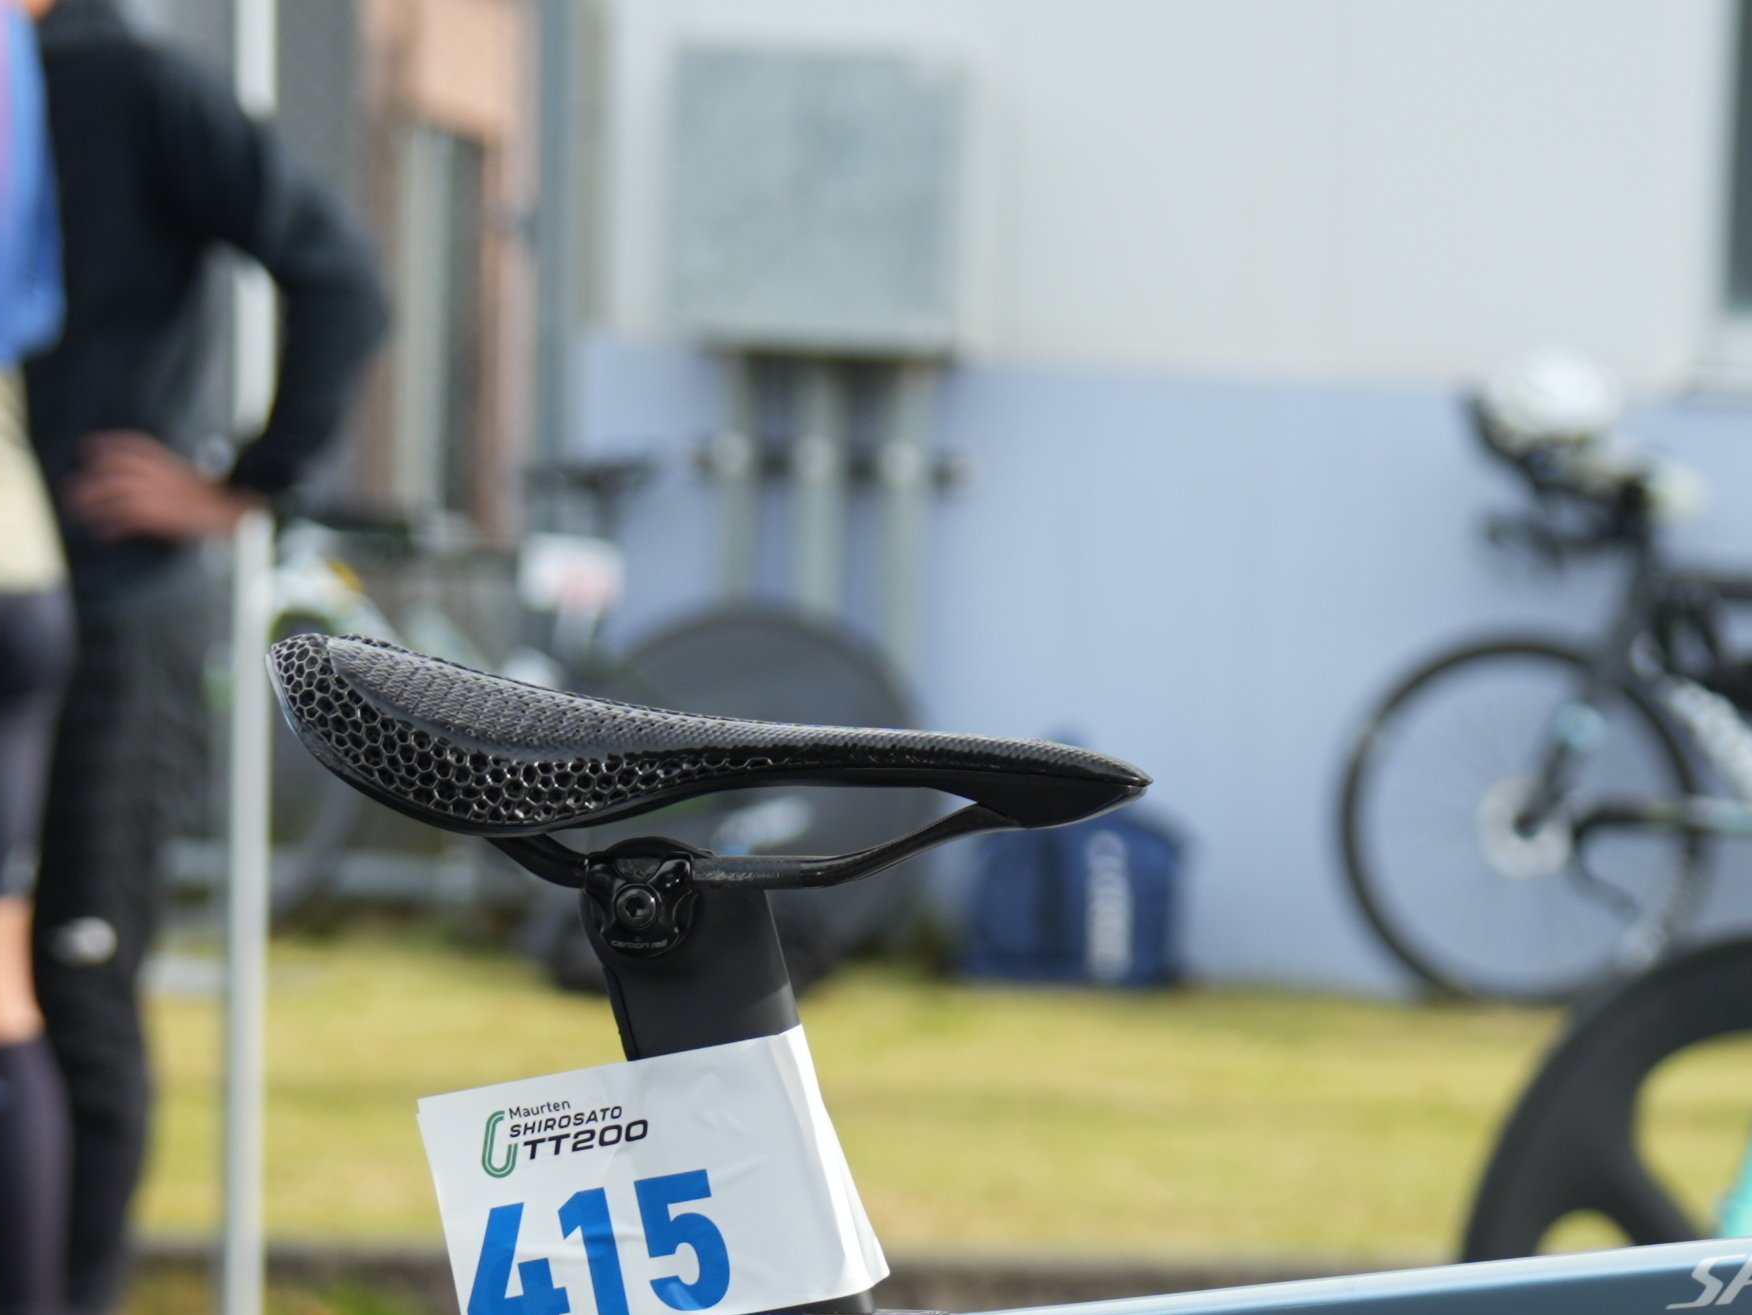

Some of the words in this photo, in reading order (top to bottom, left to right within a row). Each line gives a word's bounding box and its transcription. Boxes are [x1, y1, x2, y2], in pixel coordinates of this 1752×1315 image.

[508, 1098, 571, 1120] Maurten
[509, 1105, 622, 1139] SHIROSATO
[523, 1118, 649, 1162] TT200
